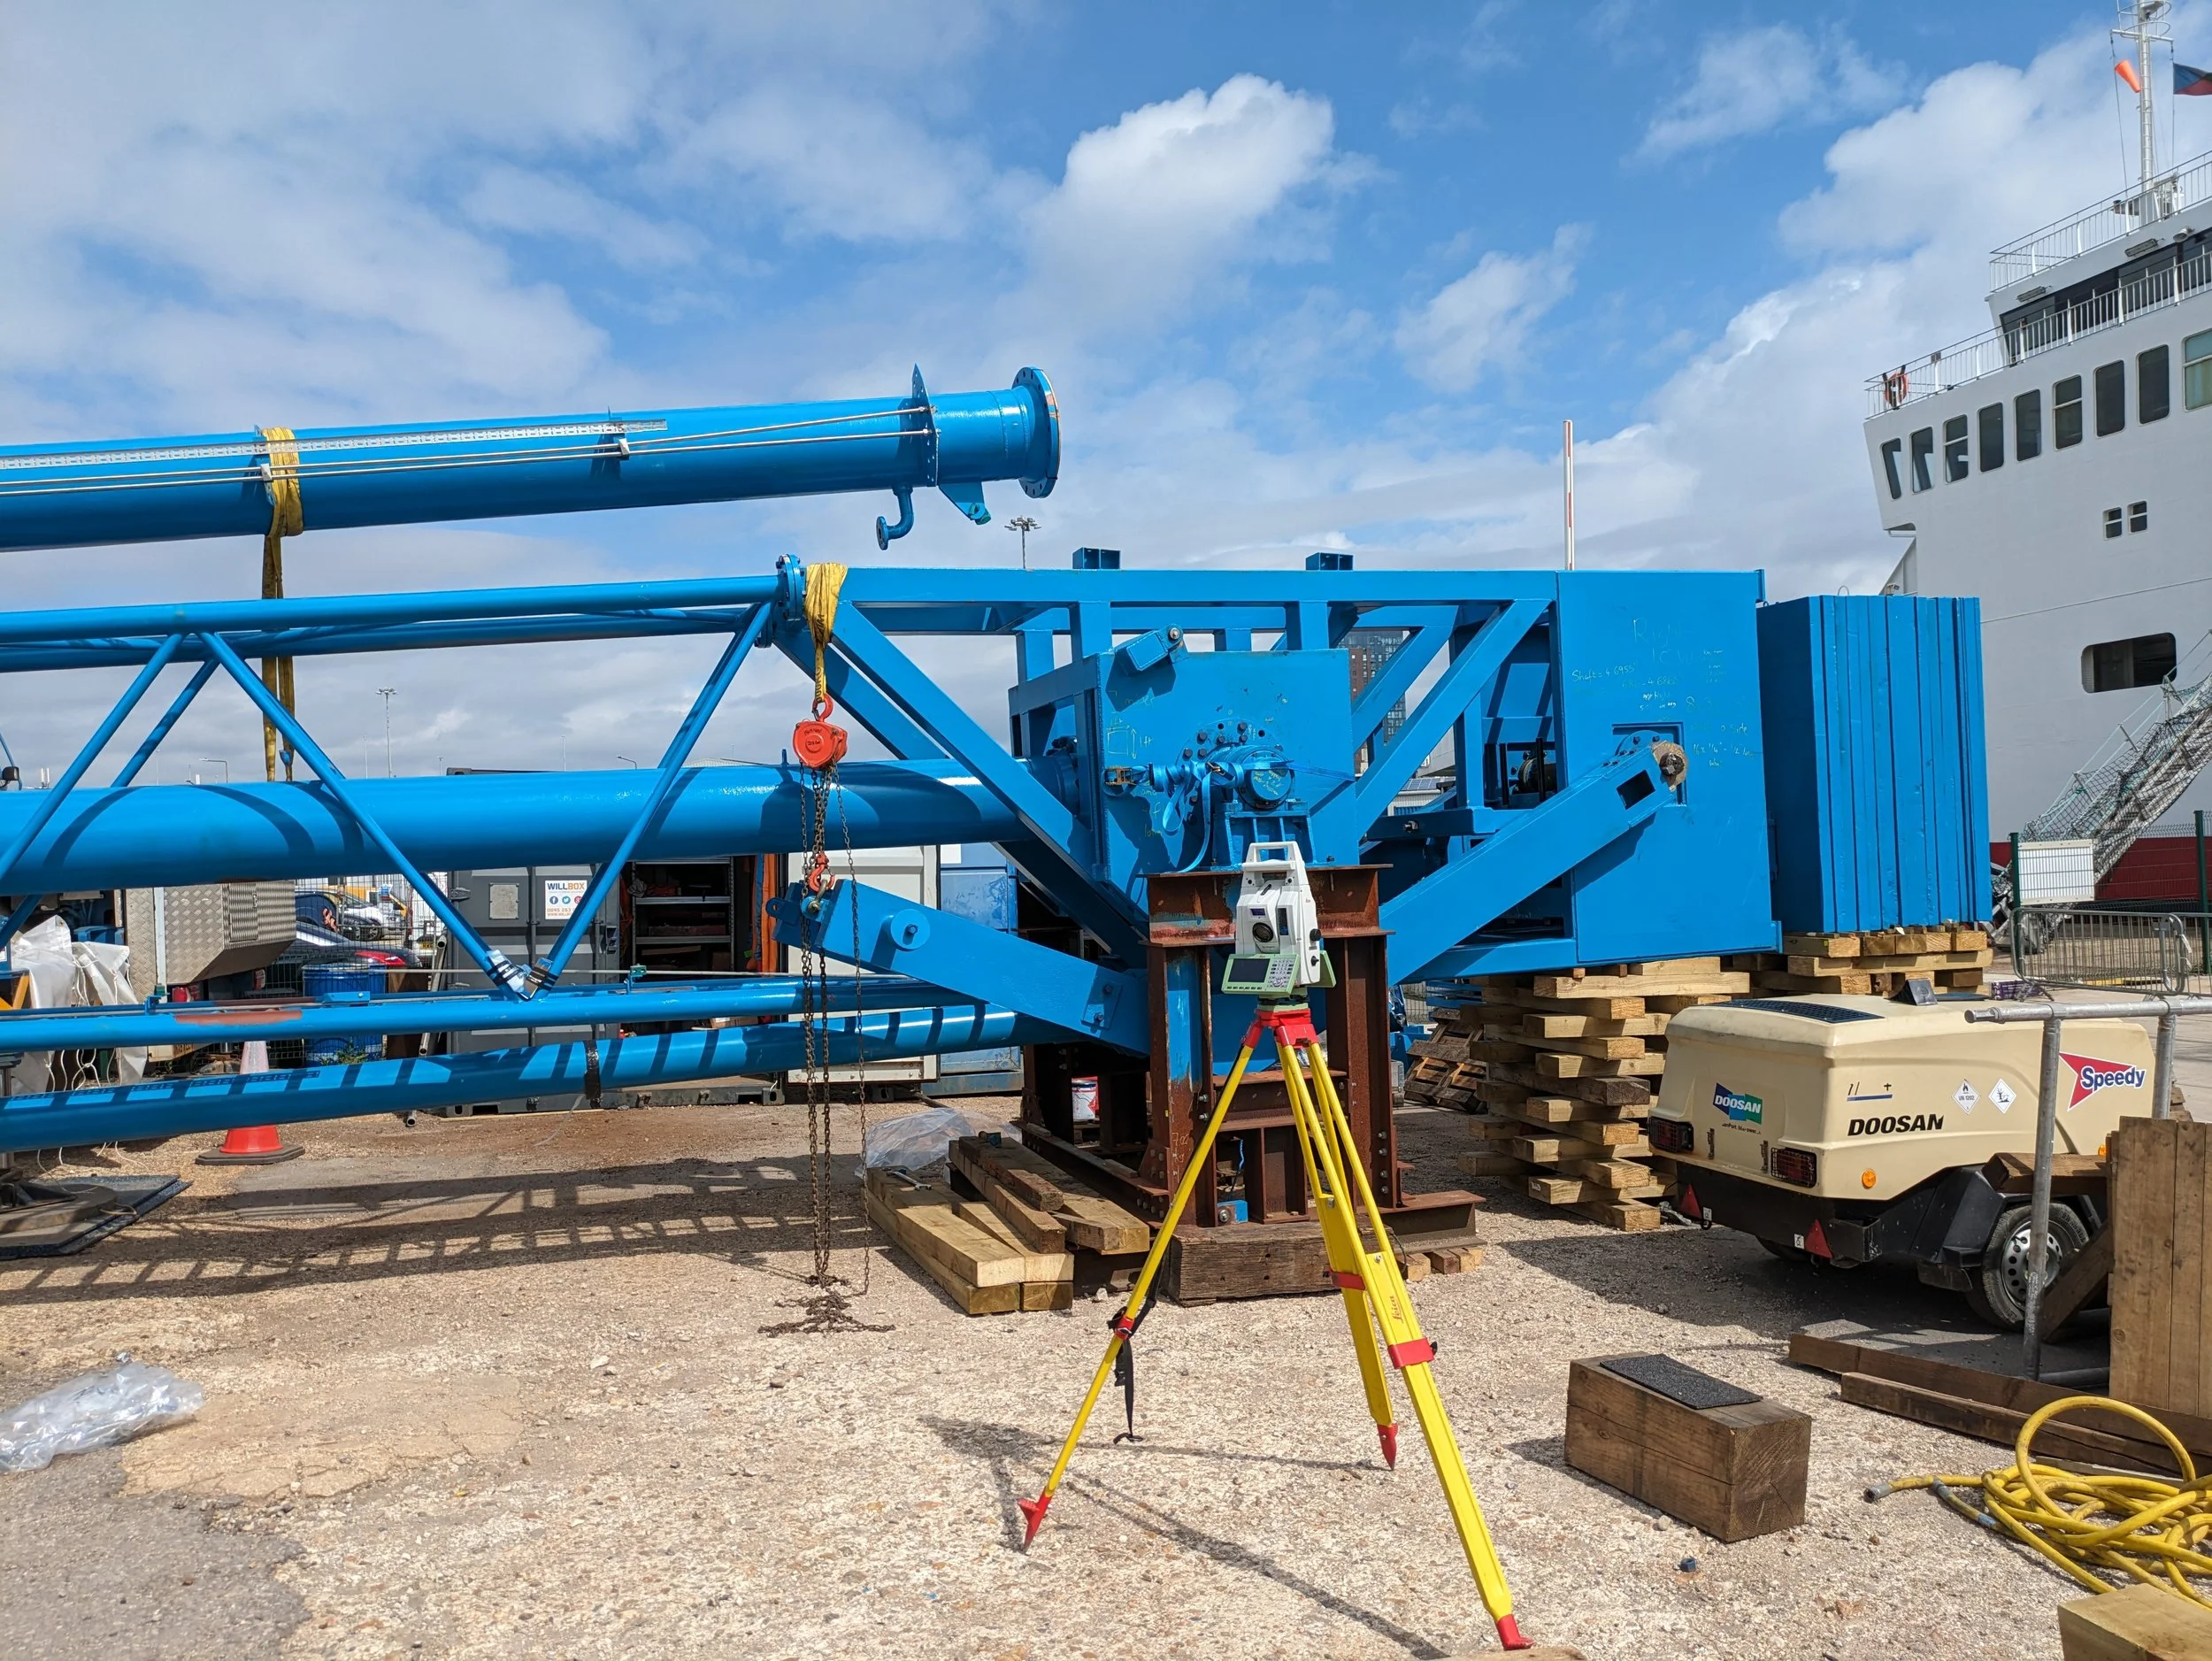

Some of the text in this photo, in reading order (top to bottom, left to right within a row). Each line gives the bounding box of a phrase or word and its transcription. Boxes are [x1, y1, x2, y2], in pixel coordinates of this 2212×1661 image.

[2082, 1066, 2146, 1091] Speedy
[1715, 1095, 1761, 1114] DOOSAN
[1847, 1113, 1944, 1136] DOOSAN
[1390, 1295, 1404, 1324] Leica
